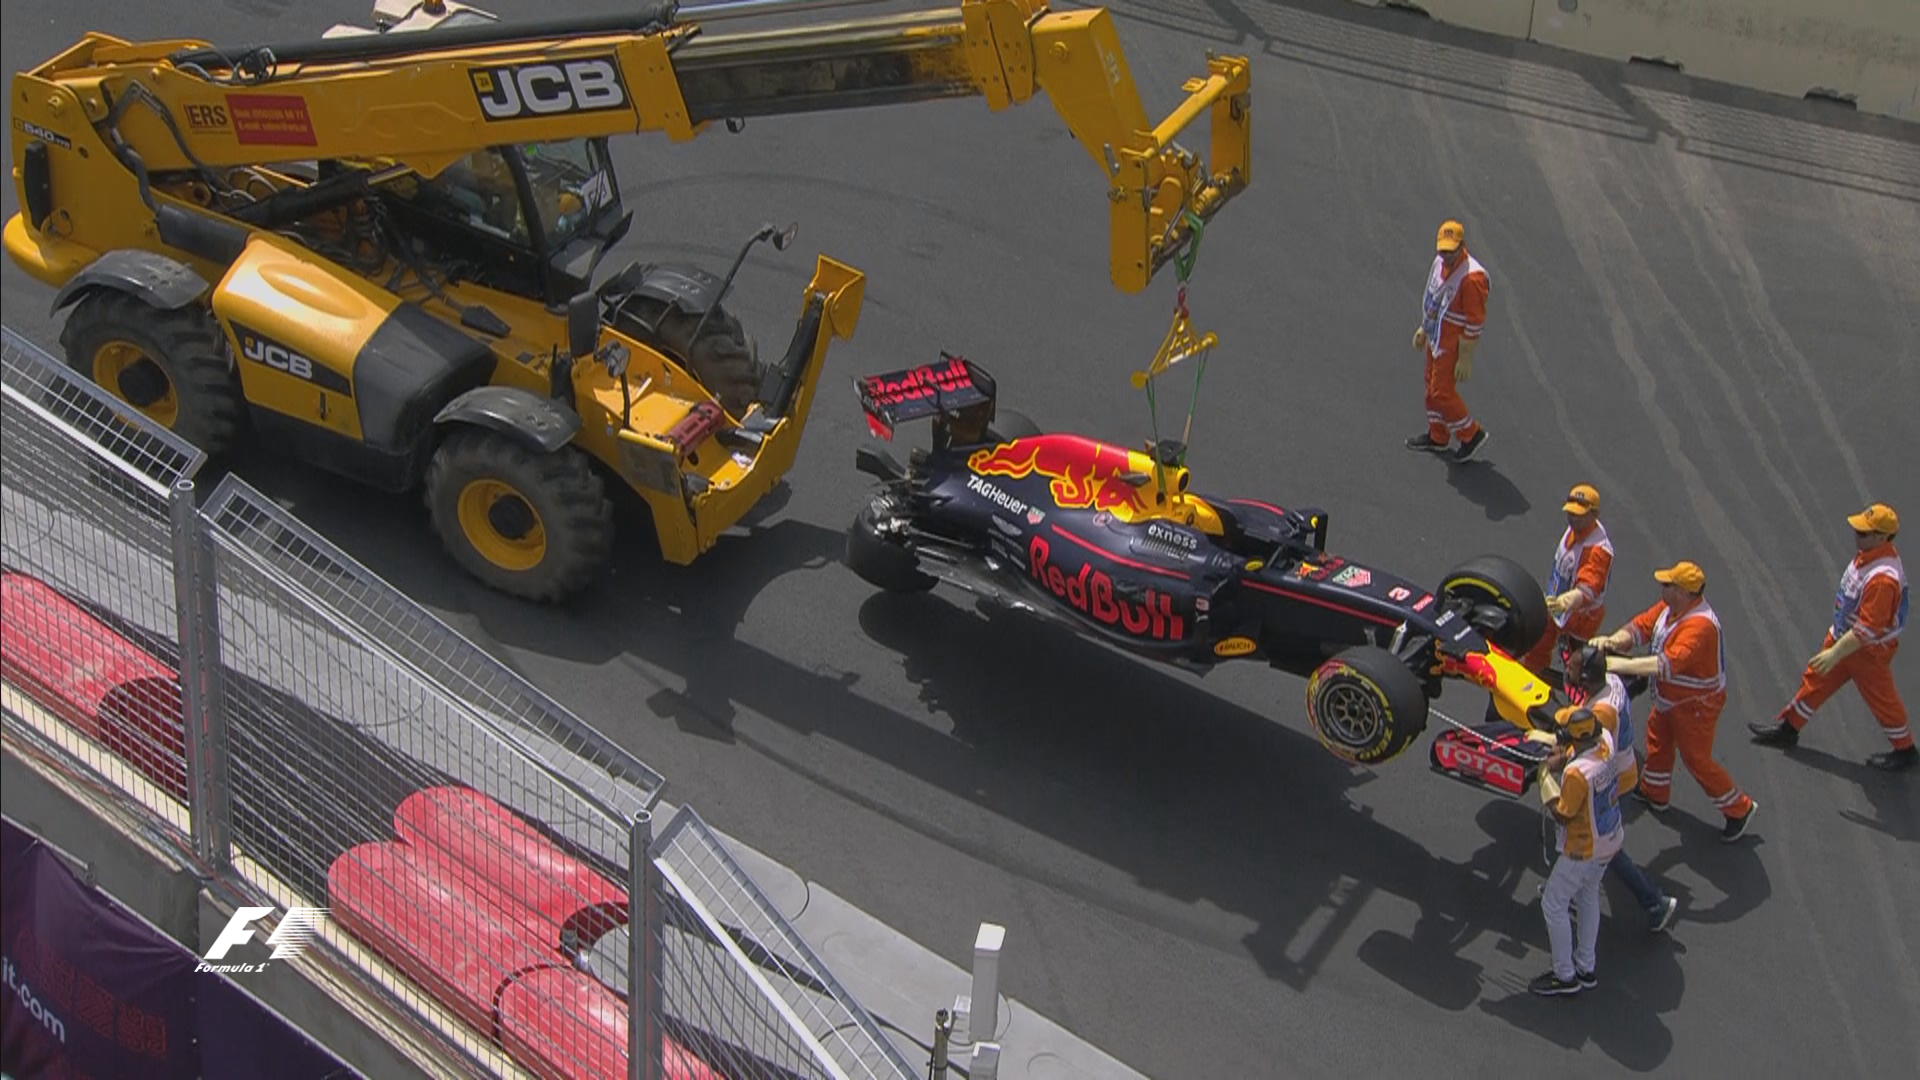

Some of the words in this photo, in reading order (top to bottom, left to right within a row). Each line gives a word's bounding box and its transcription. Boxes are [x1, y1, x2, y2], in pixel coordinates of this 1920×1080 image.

[480, 59, 624, 118] JCB
[190, 104, 228, 127] ERS
[244, 340, 313, 379] JCB
[1147, 524, 1199, 551] exness
[1437, 741, 1523, 785] TOTAL
